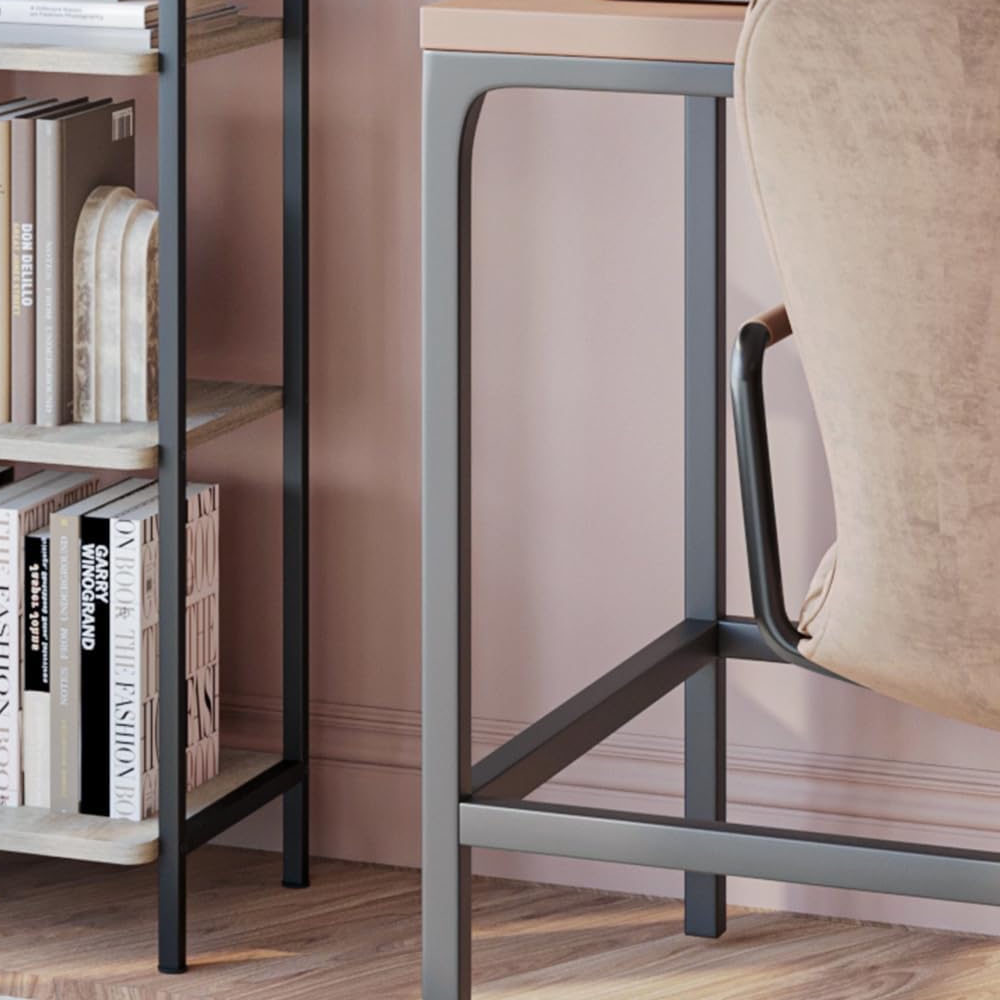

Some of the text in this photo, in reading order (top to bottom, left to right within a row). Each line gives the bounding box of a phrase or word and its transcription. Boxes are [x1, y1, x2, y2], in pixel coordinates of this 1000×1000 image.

[21, 223, 34, 307] DON DELILLO
[81, 543, 96, 651] WINOGRAND
[95, 544, 109, 604] GARRY
[114, 628, 136, 677] THE
[114, 681, 137, 778] FASHION
